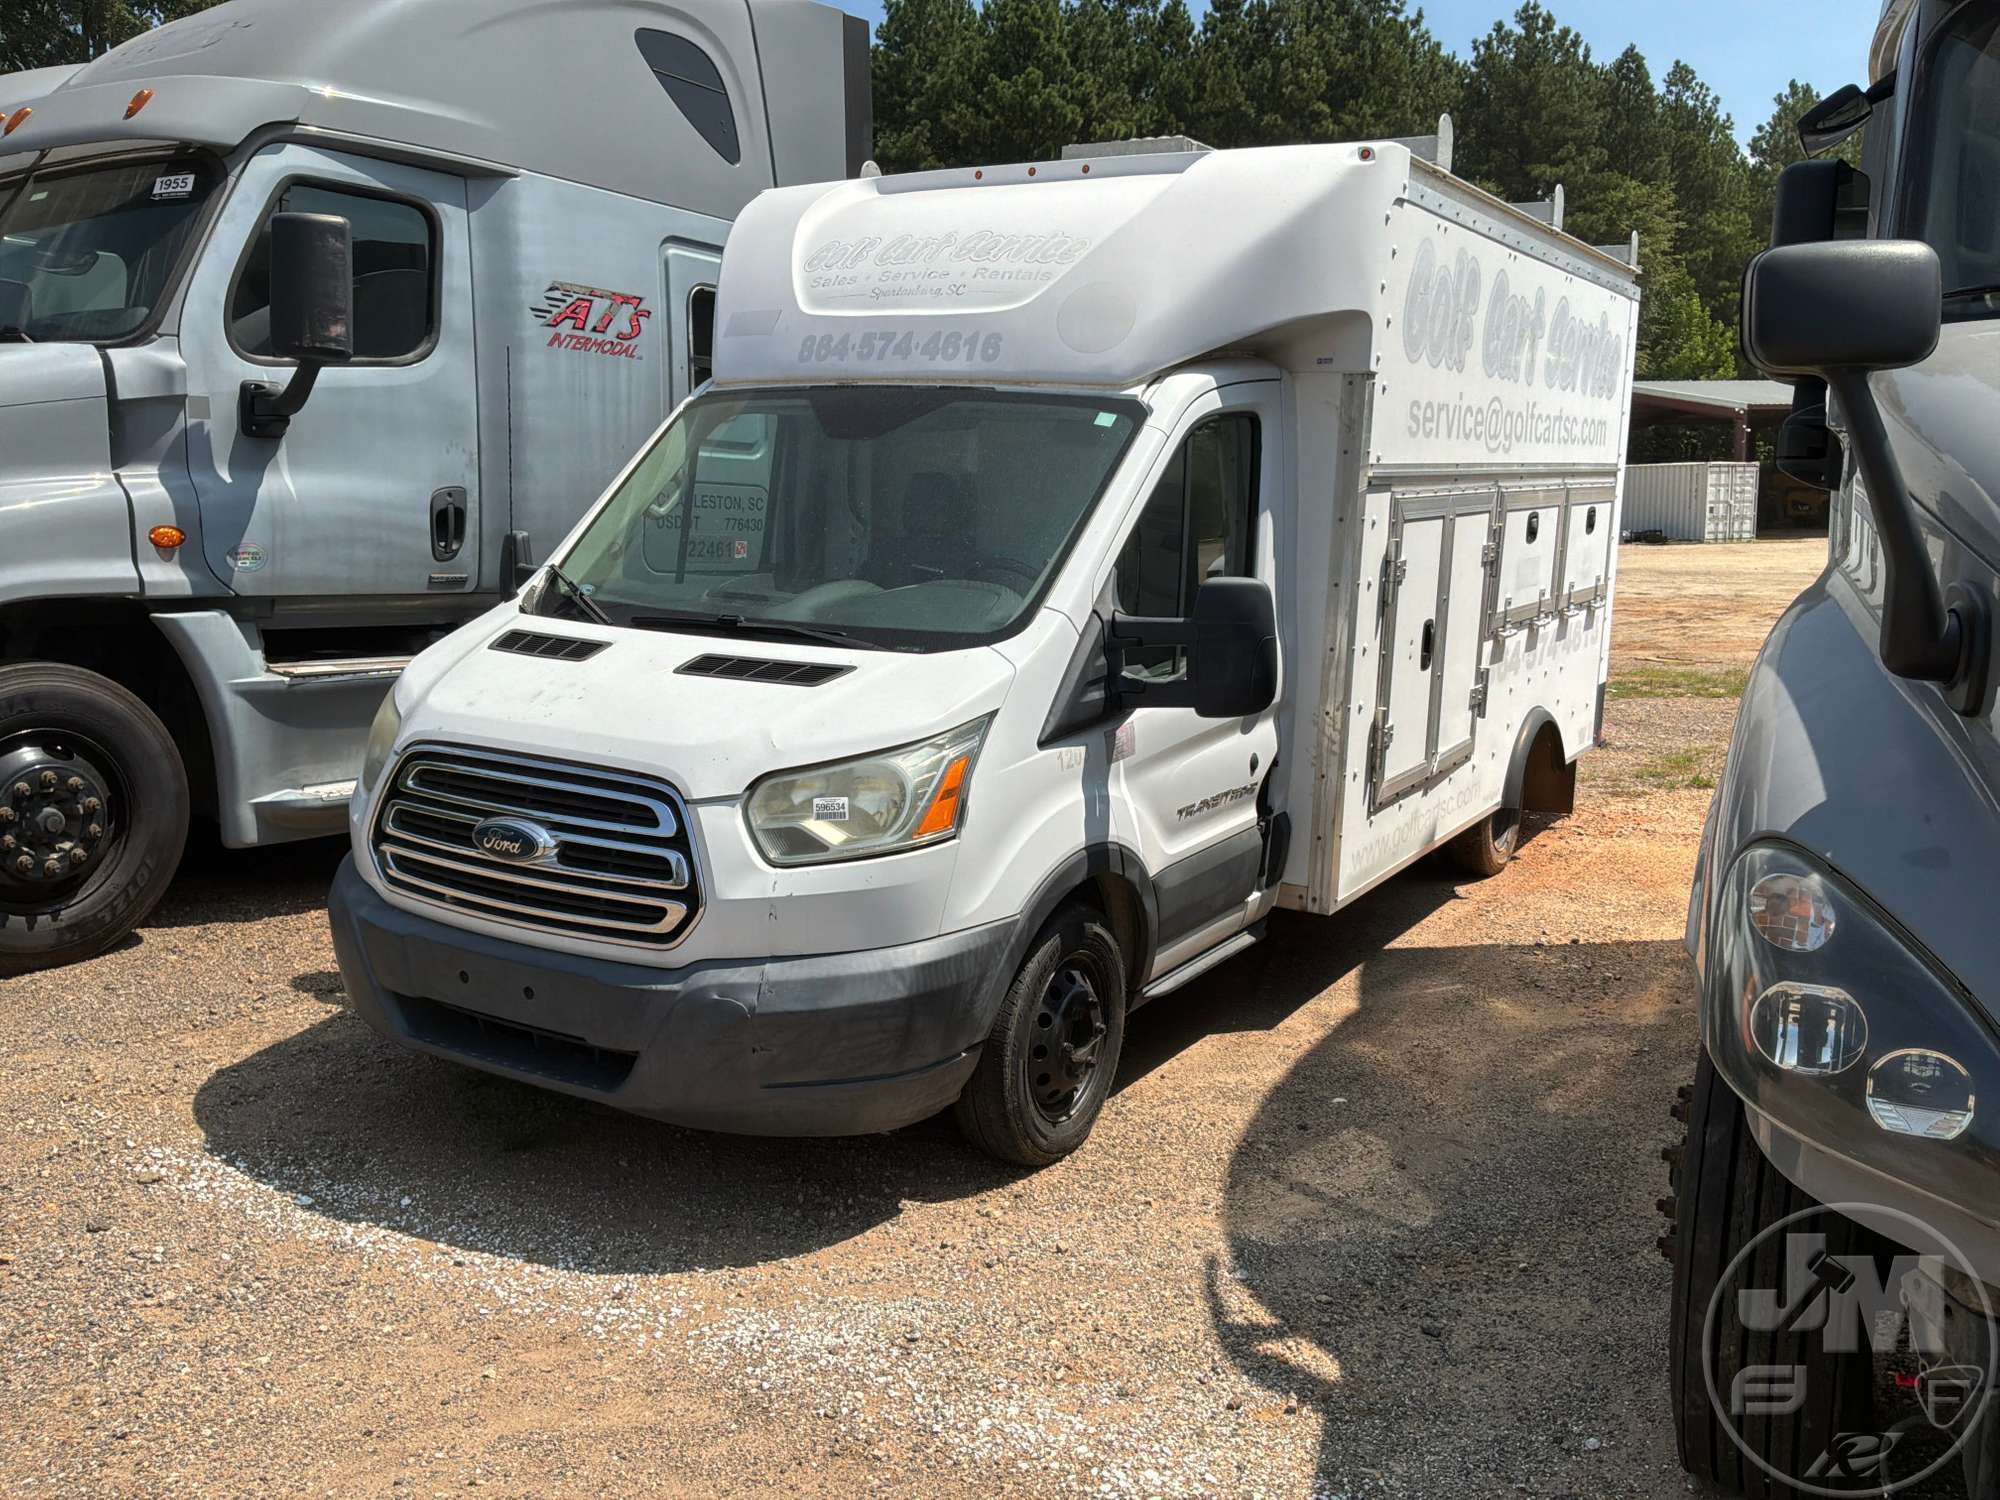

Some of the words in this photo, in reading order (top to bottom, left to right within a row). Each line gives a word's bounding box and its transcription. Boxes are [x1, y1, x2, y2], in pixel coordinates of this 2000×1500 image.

[159, 177, 189, 191] 1955
[810, 275, 858, 288] Sales
[878, 269, 950, 282] Service
[972, 267, 1053, 281] Rentals
[547, 333, 637, 359] INTERMODAL
[1408, 392, 1607, 453] service@golfcartsc.com
[815, 802, 846, 812] 596534
[483, 828, 521, 854] Ford
